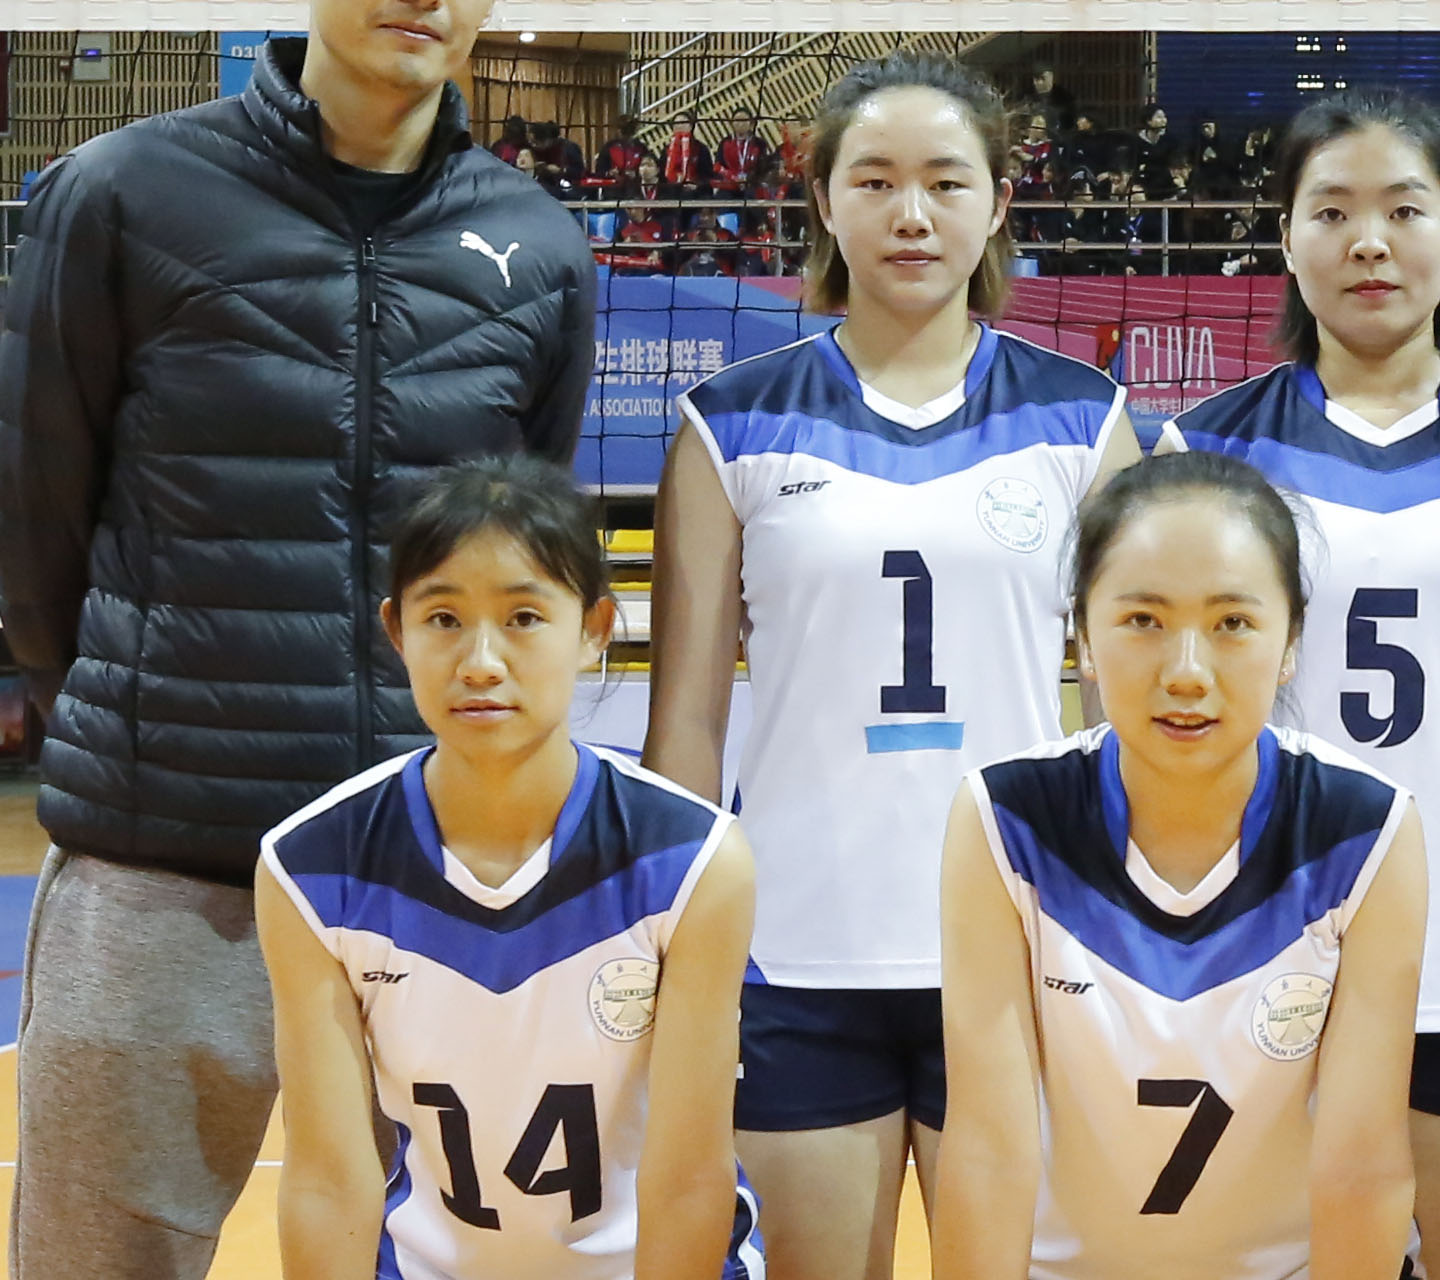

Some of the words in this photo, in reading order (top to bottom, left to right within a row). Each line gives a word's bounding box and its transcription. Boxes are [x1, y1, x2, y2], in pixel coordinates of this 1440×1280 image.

[1131, 327, 1216, 389] CUVA
[777, 480, 831, 497] star
[880, 549, 947, 713] 1
[1340, 587, 1425, 748] 5
[412, 1082, 602, 1231] 14
[1137, 1078, 1235, 1215] 7
